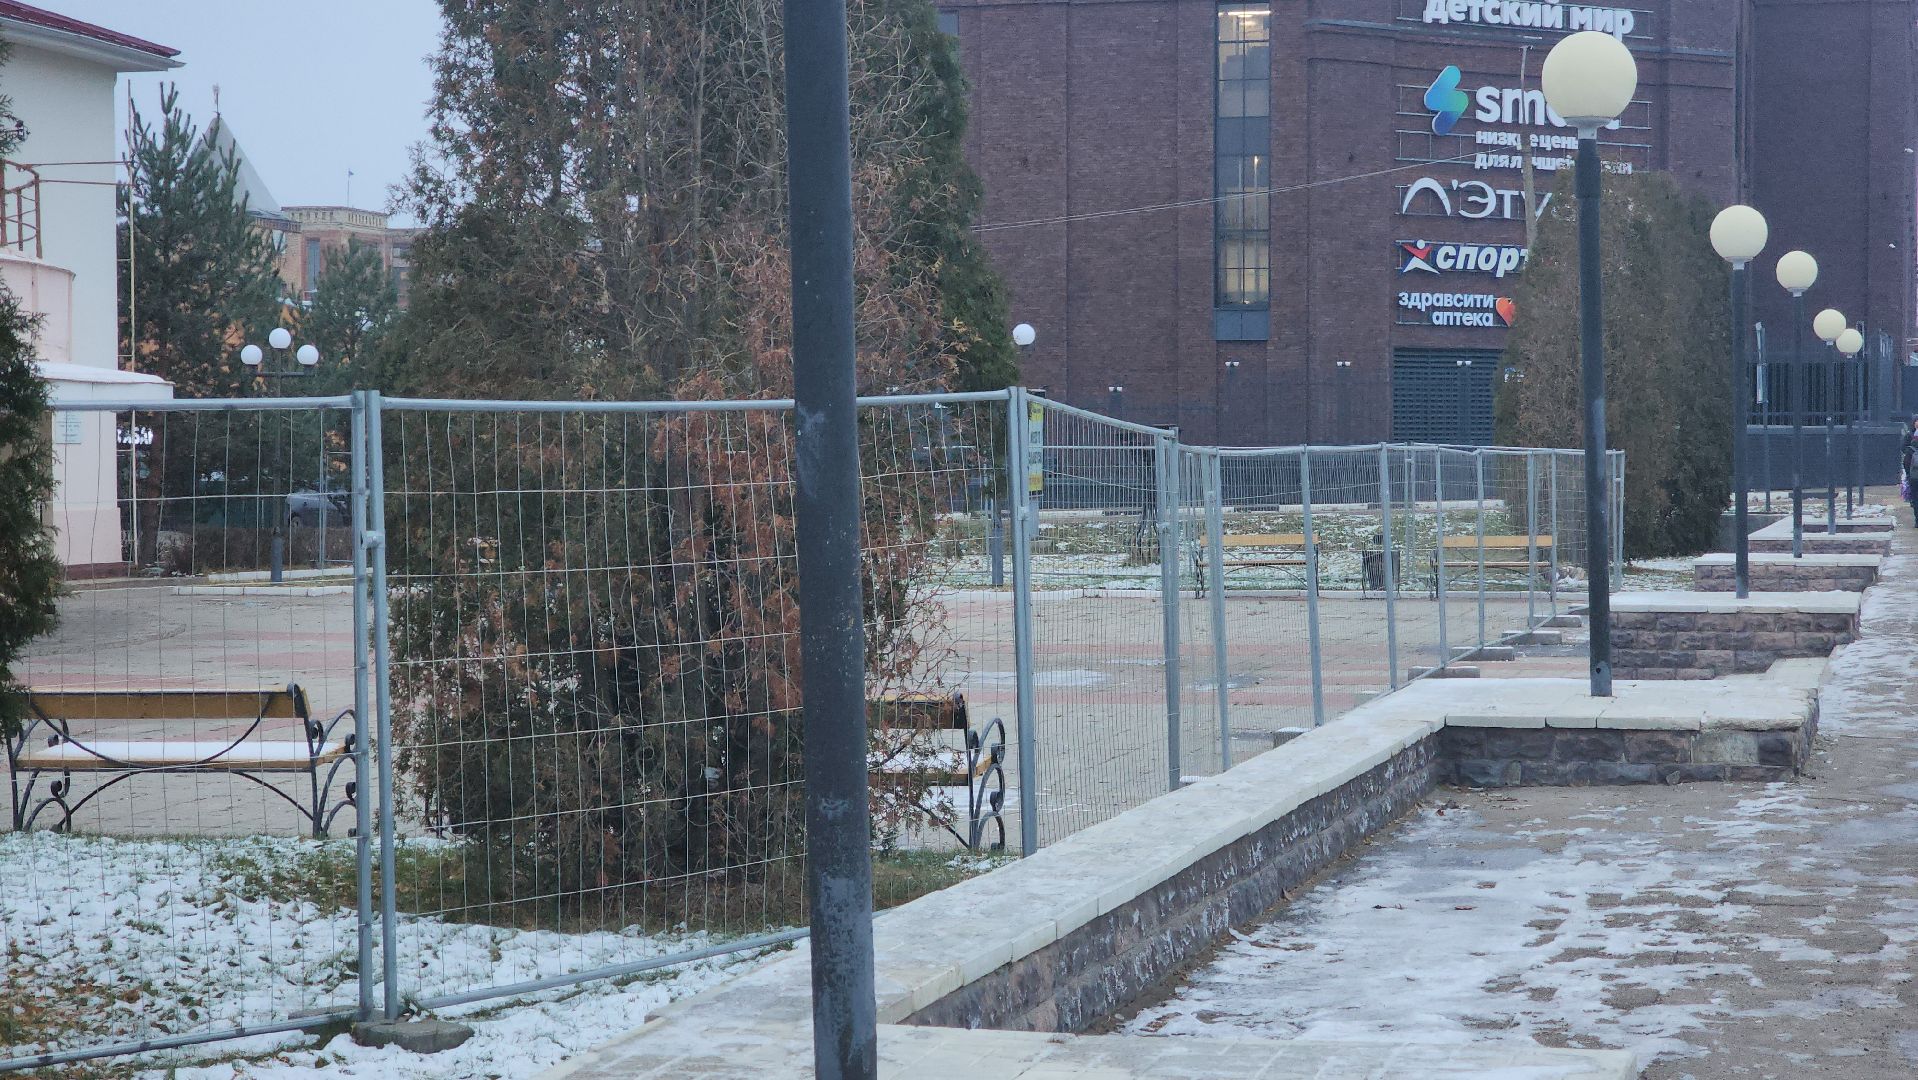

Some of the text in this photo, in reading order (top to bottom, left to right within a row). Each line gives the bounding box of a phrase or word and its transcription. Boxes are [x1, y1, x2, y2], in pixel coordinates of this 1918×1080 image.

[1569, 7, 1635, 42] мир
[1398, 291, 1494, 312] здравсити
[1432, 311, 1494, 327] аптека
